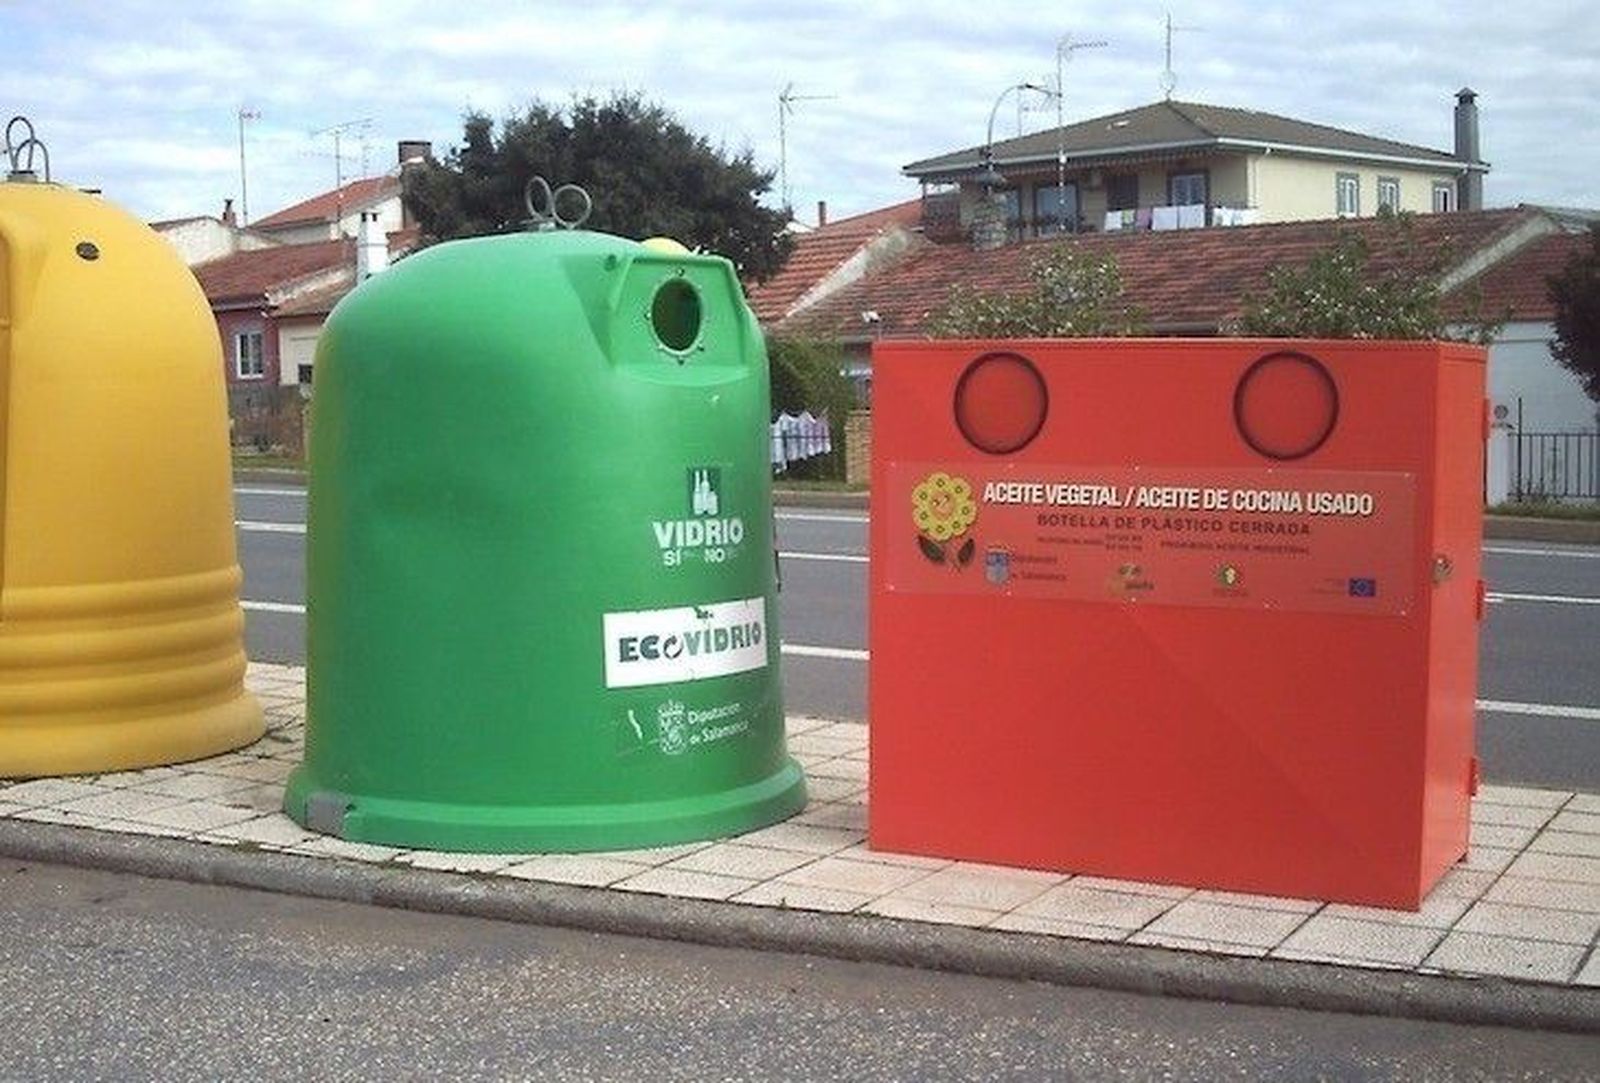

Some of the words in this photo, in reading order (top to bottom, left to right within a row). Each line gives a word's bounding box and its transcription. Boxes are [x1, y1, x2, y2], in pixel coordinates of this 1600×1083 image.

[983, 483, 1044, 504] ACEITE
[1046, 485, 1121, 507] VEGETAL
[1136, 487, 1200, 509] ACEITE
[1203, 489, 1228, 510] DE
[1232, 489, 1303, 513] COCINA
[1307, 491, 1373, 516] USADO
[652, 518, 743, 548] VIDRIO
[1037, 514, 1109, 529] BOTELLA
[1115, 516, 1135, 529] DE
[1229, 520, 1310, 535] CERRADA
[704, 548, 726, 563] NO
[619, 622, 761, 662] ECOVIDRIO
